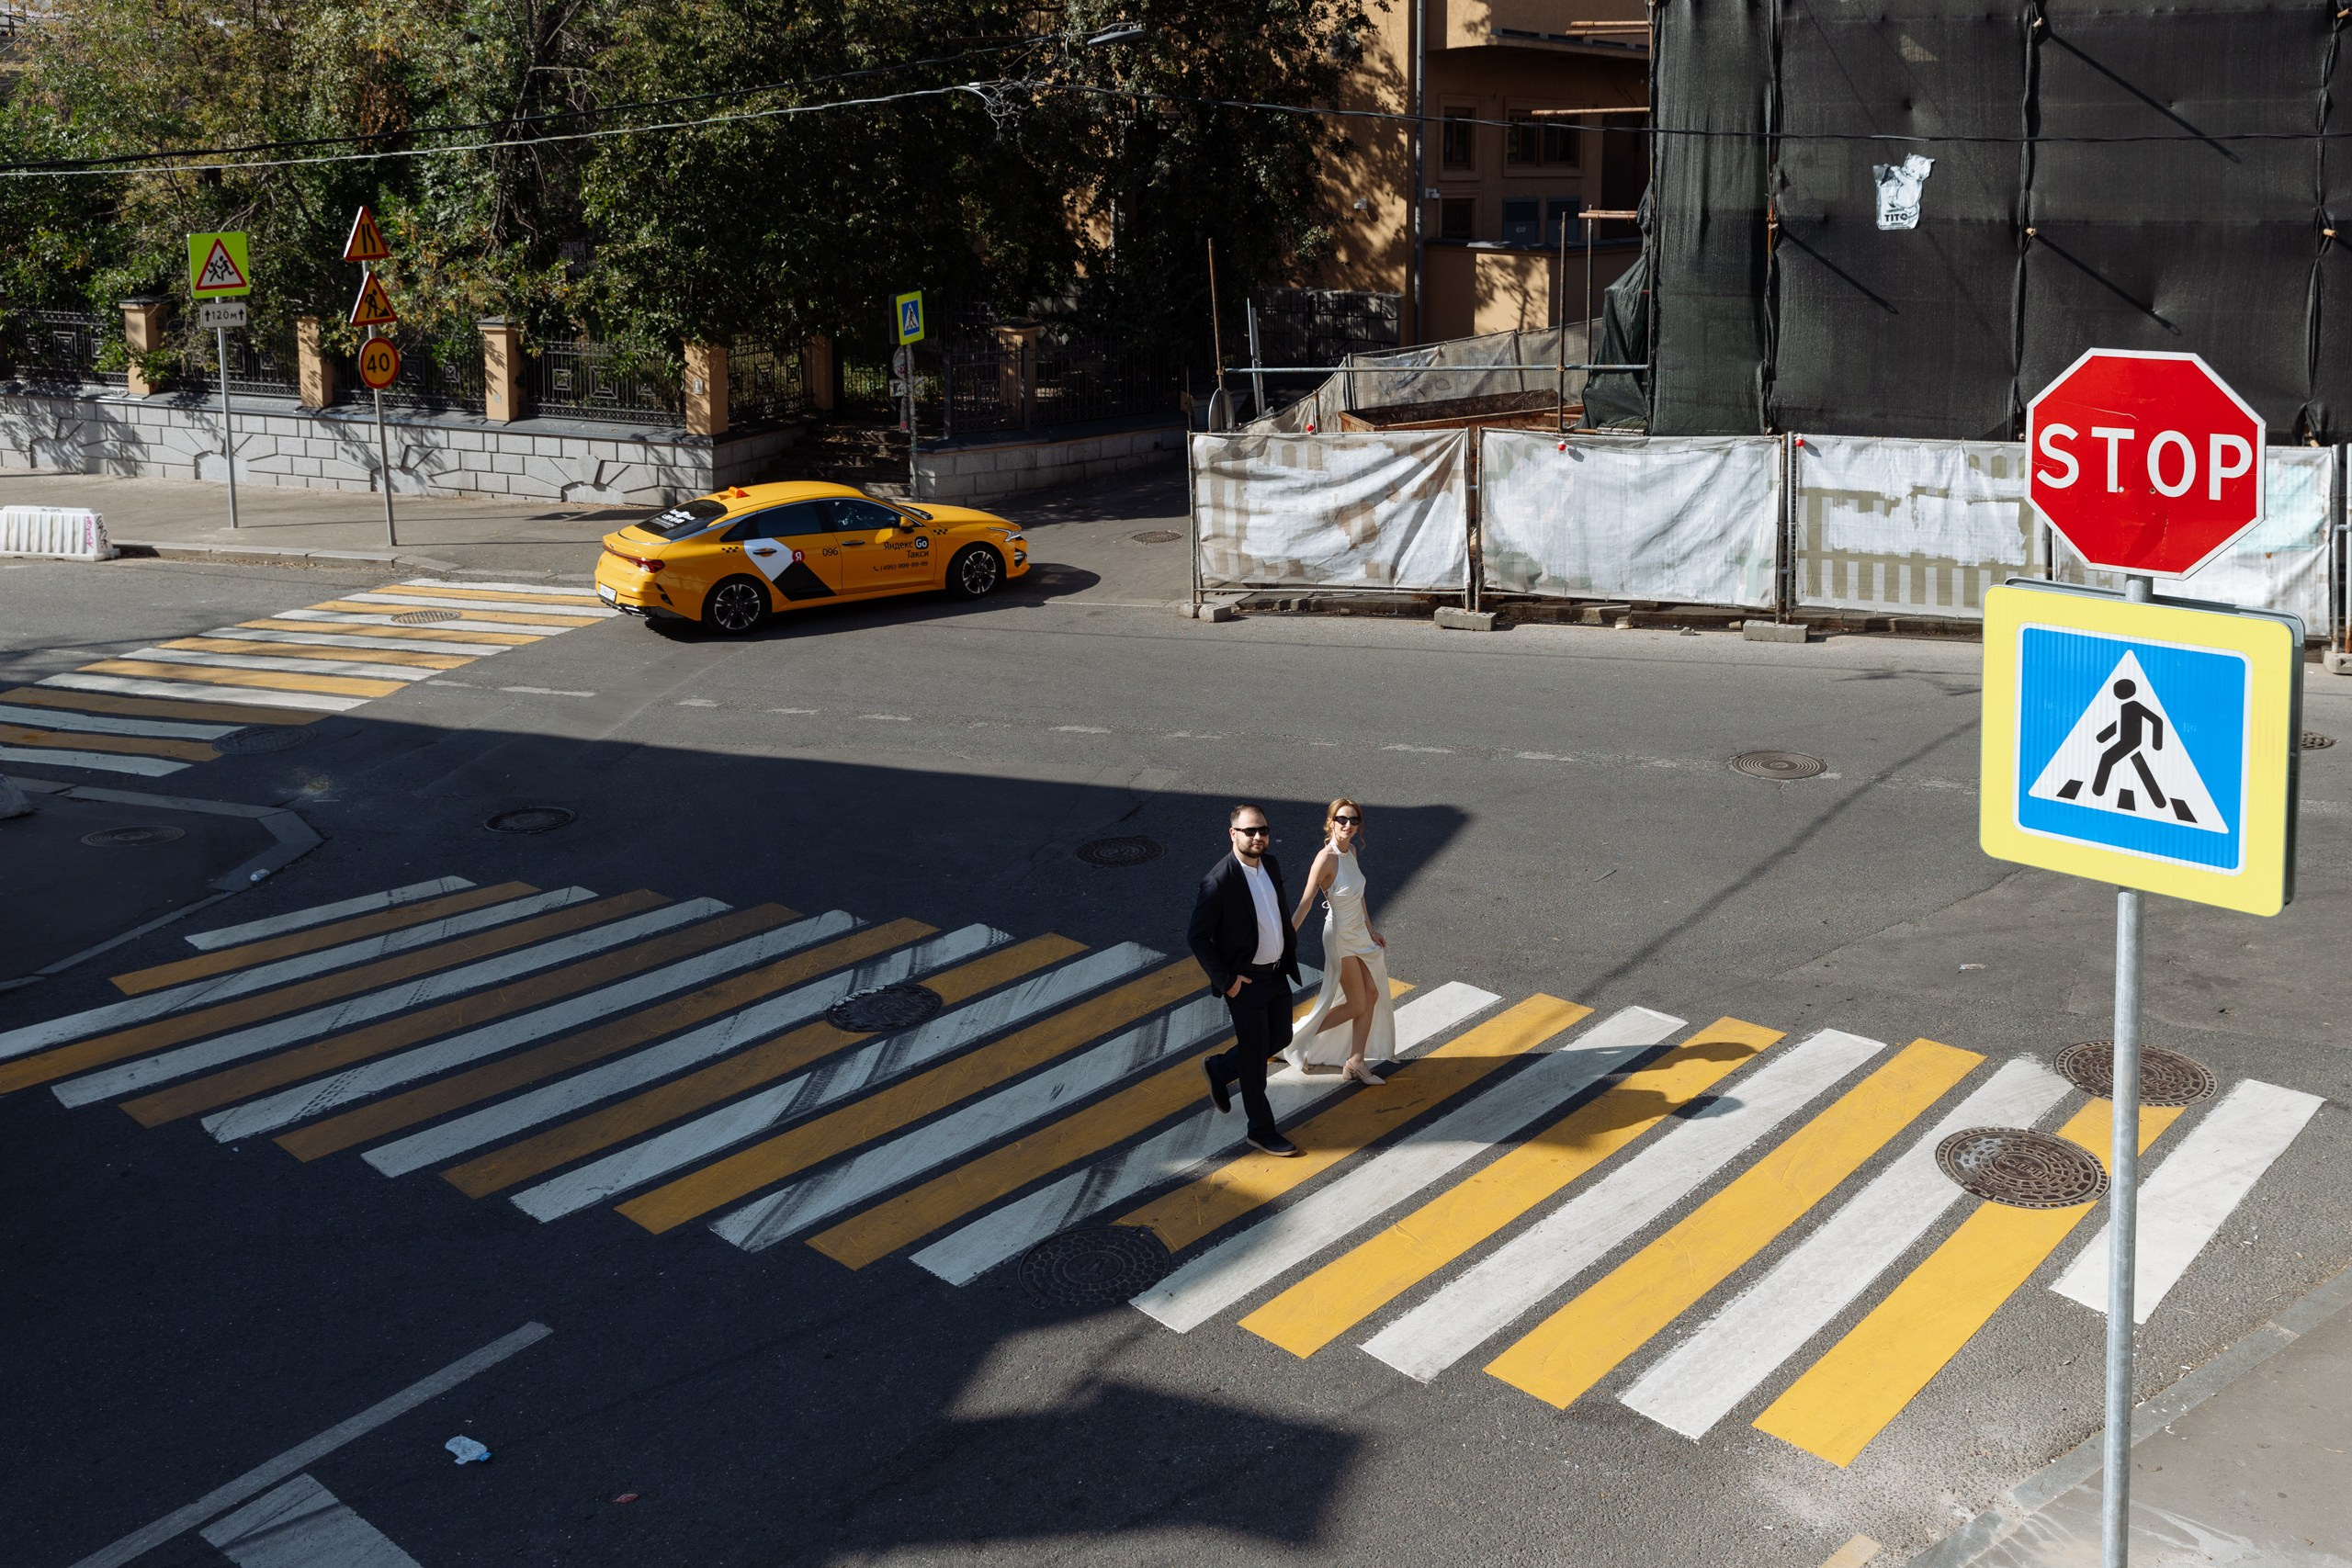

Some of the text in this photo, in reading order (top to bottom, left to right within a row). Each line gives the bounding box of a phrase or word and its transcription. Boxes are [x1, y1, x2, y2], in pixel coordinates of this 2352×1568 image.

[367, 352, 390, 374] 40
[2036, 423, 2254, 502] STOP
[883, 538, 928, 551] Яндекс Go
[821, 547, 840, 557] 096
[906, 549, 929, 558] Такси
